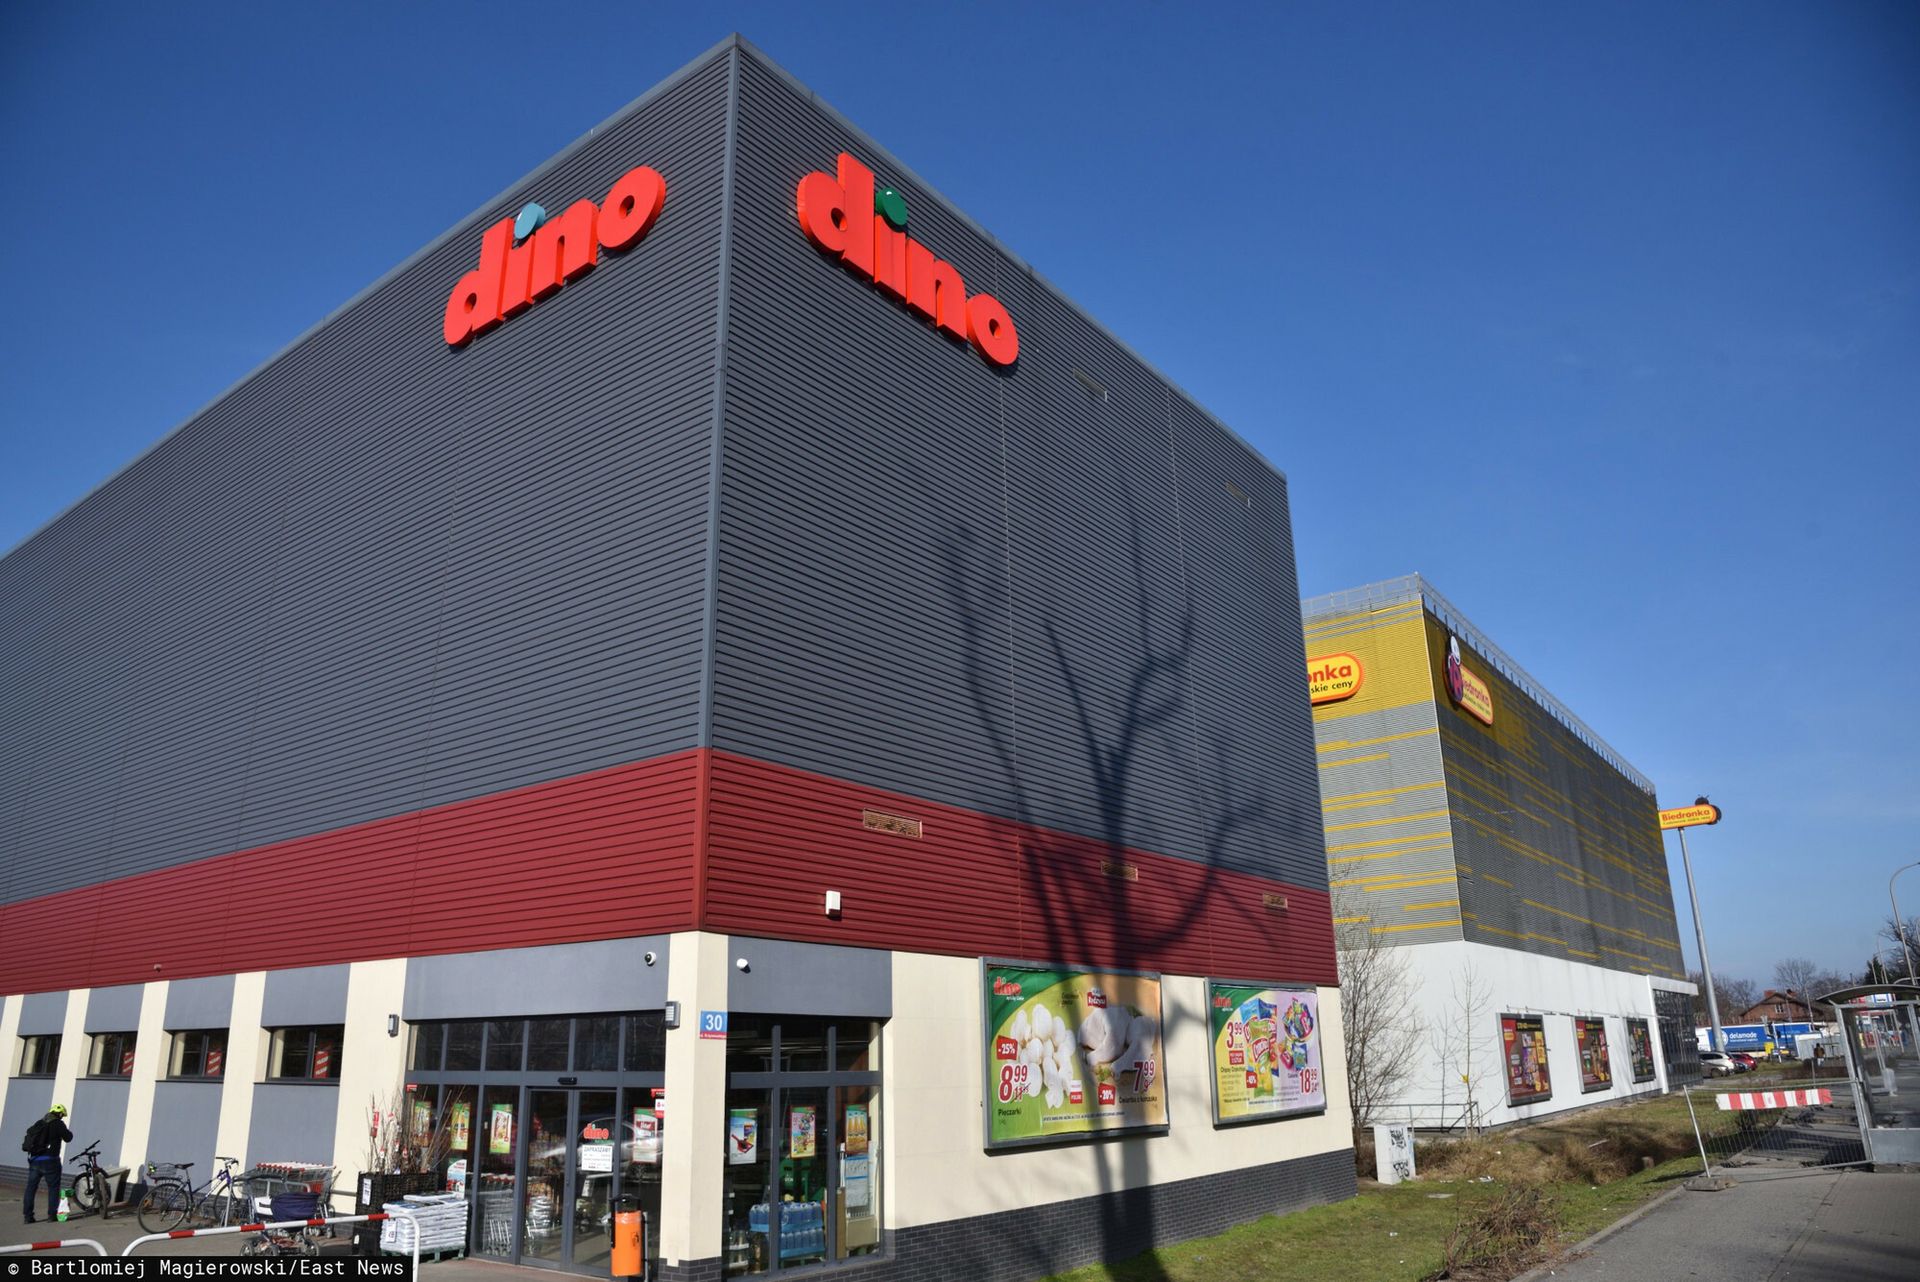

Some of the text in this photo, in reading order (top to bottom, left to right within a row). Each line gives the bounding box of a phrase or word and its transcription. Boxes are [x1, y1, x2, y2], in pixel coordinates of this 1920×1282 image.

[443, 166, 667, 346] dino
[796, 152, 1019, 366] dino
[1331, 680, 1353, 690] ceny
[1661, 809, 1710, 822] Biedronka
[705, 1014, 723, 1031] 30
[1729, 1031, 1757, 1040] delamode
[998, 1108, 1021, 1116] Pieczarki
[584, 1123, 609, 1140] dino
